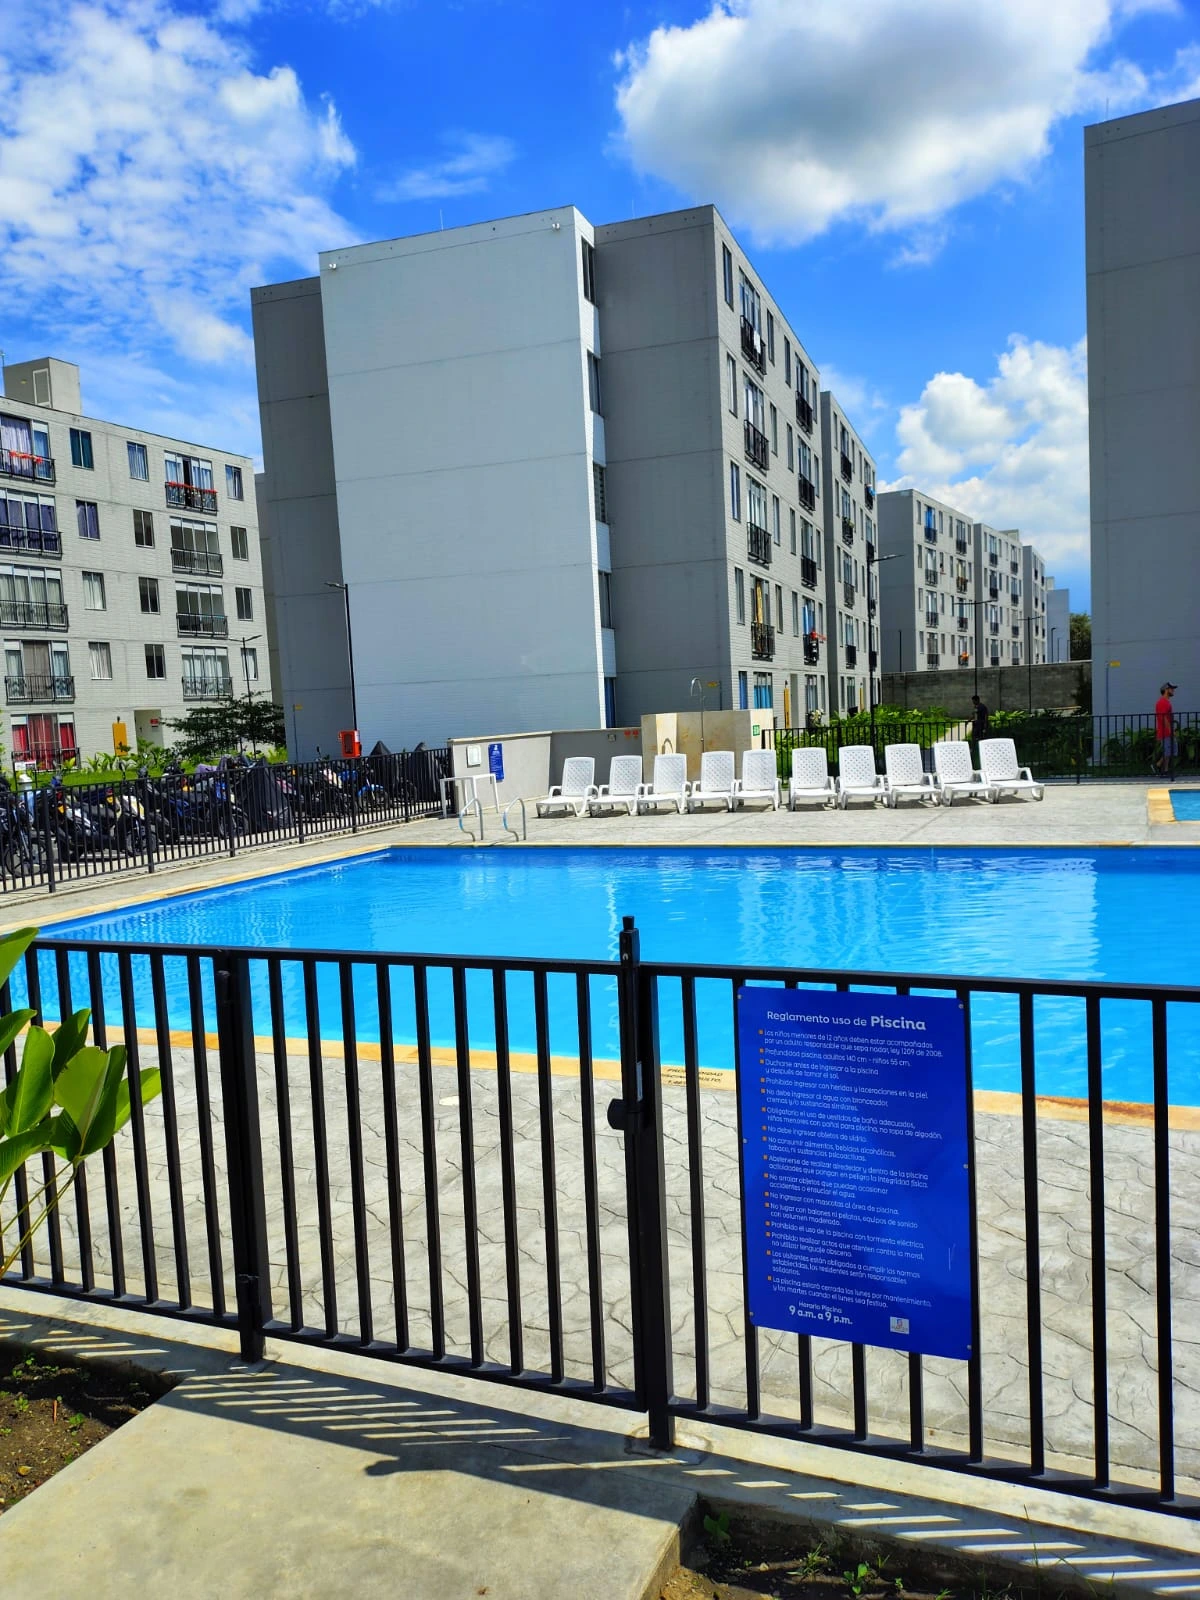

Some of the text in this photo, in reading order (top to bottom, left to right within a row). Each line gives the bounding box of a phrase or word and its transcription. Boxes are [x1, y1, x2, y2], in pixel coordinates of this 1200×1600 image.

[767, 1011, 926, 1030] Reglamento uso de Piscina
[789, 1305, 796, 1316] 9
[798, 1309, 816, 1319] a.m.
[825, 1311, 832, 1322] 9
[834, 1315, 853, 1326] p.m.
